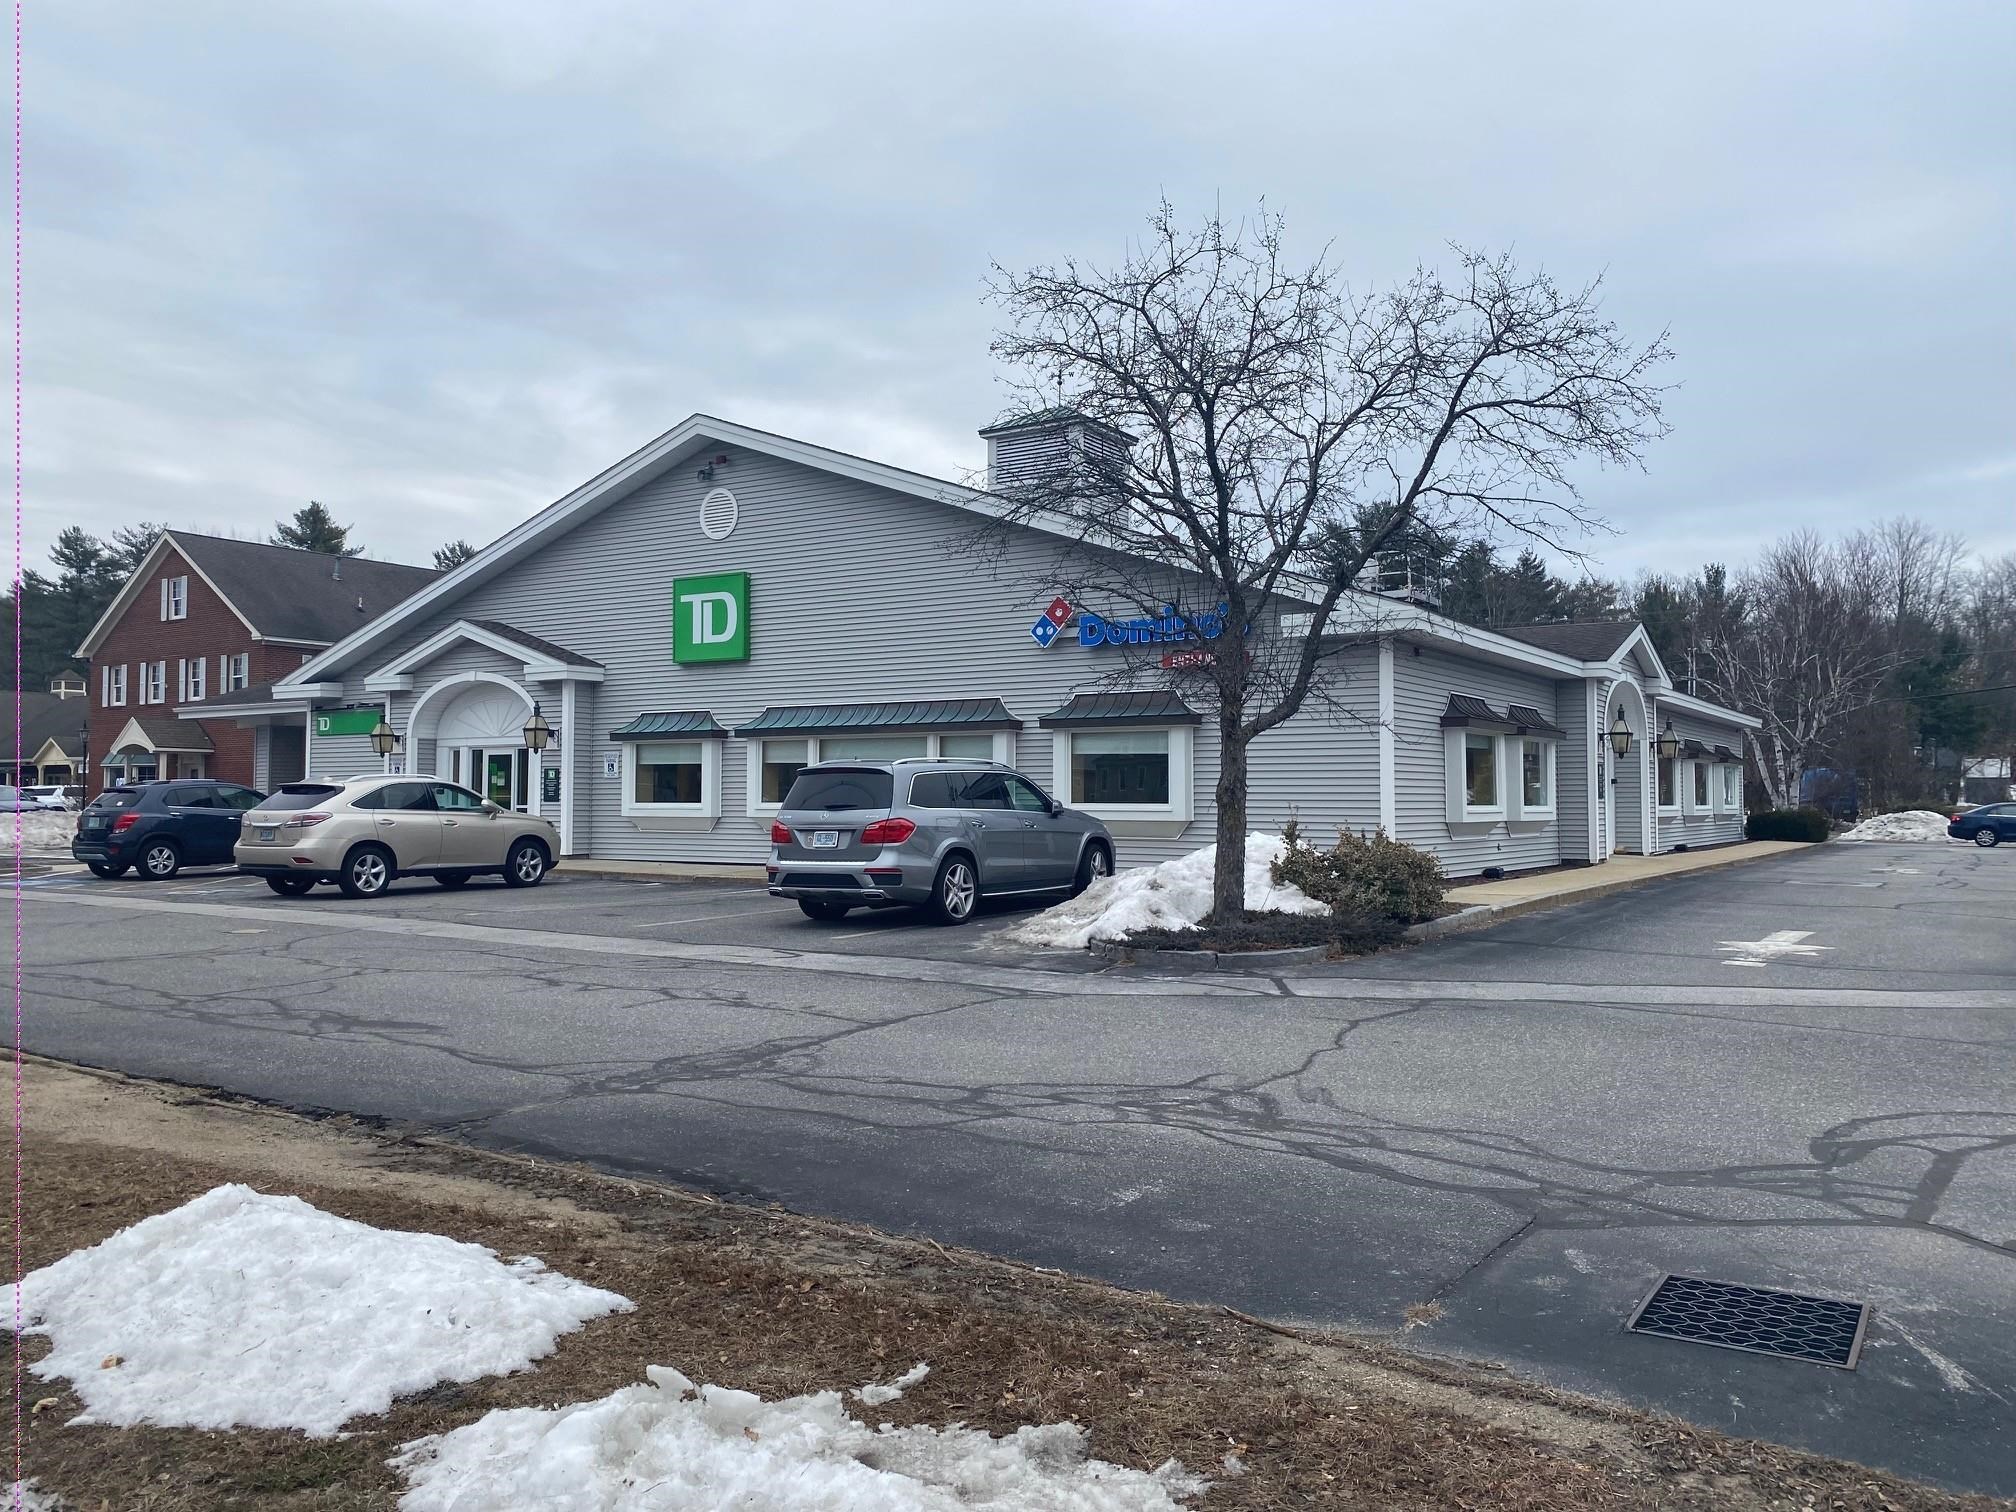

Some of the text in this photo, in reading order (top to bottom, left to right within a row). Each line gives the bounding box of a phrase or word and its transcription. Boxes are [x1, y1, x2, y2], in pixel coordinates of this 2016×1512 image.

[680, 591, 738, 645] TD
[1079, 602, 1247, 647] Domino'
[317, 717, 330, 731] TD
